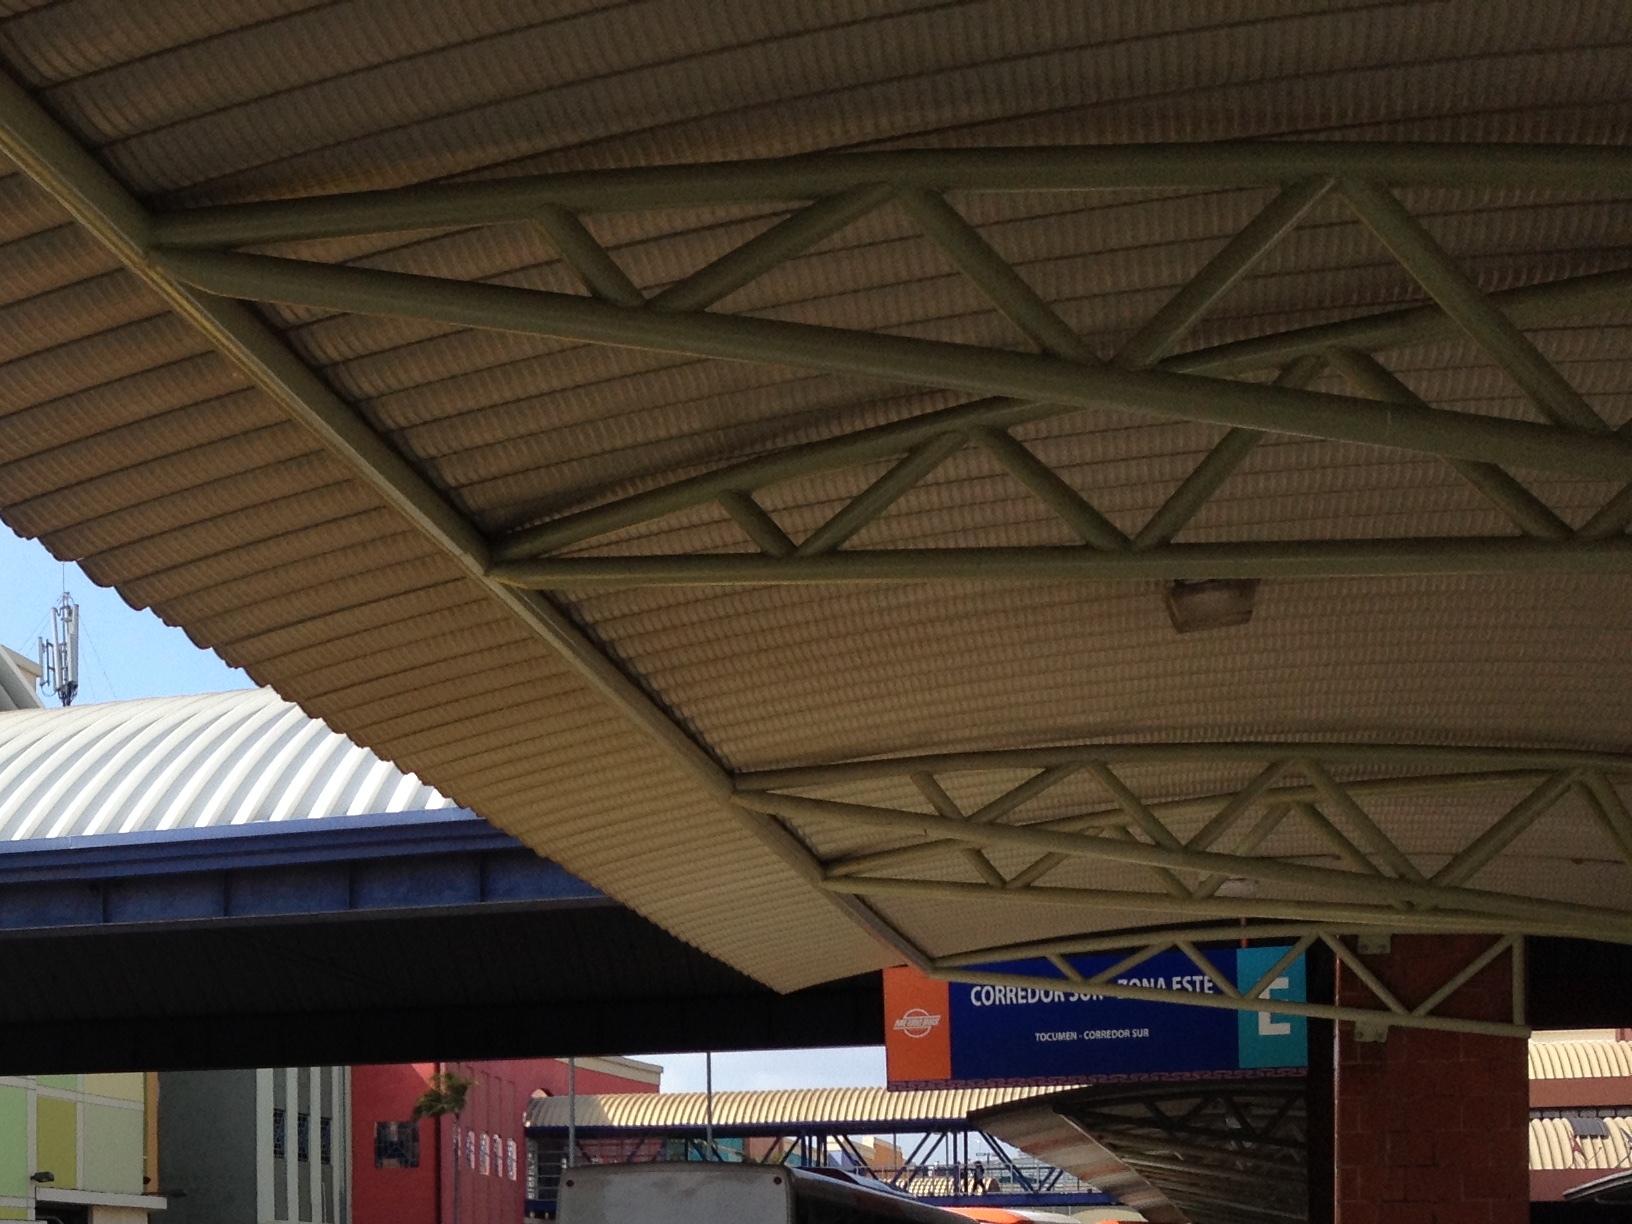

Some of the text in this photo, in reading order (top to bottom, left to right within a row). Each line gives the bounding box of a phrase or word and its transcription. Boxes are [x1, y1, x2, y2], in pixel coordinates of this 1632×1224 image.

[970, 985, 1065, 1006] CORREDOR
[1035, 1031, 1077, 1042] TOCUMEN
[1083, 1029, 1131, 1040] CORREDOR
[1132, 1028, 1150, 1038] SUR
